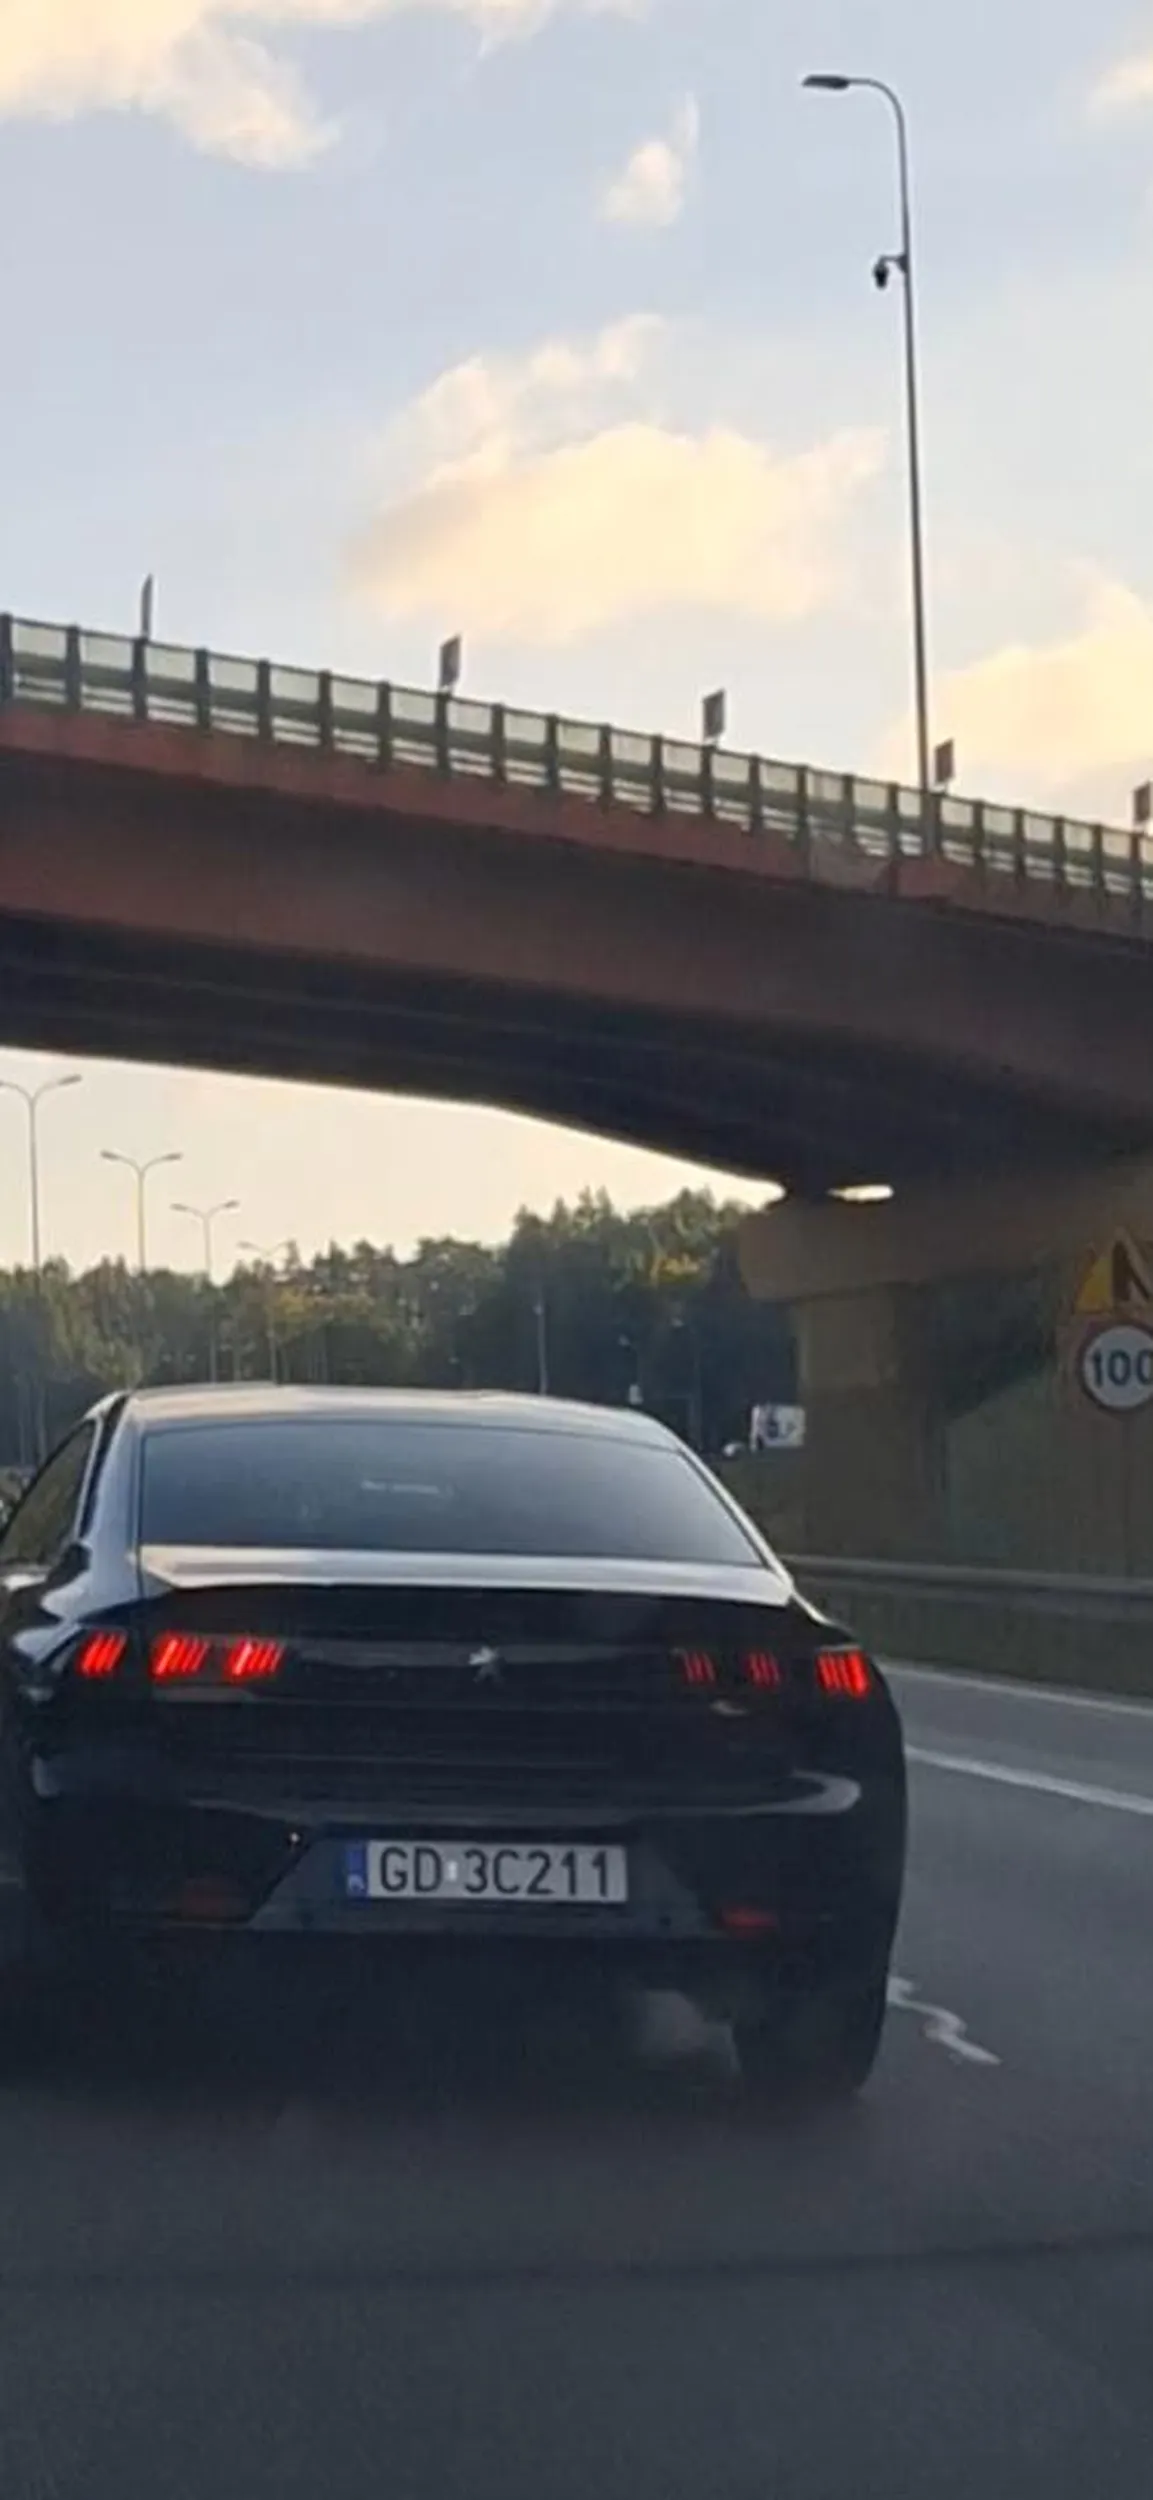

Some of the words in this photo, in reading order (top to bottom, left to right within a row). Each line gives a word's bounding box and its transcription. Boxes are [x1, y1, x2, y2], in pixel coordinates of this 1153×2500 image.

[1092, 1349, 1153, 1388] 100
[380, 1847, 442, 1892] GD
[464, 1849, 607, 1897] 3C211
